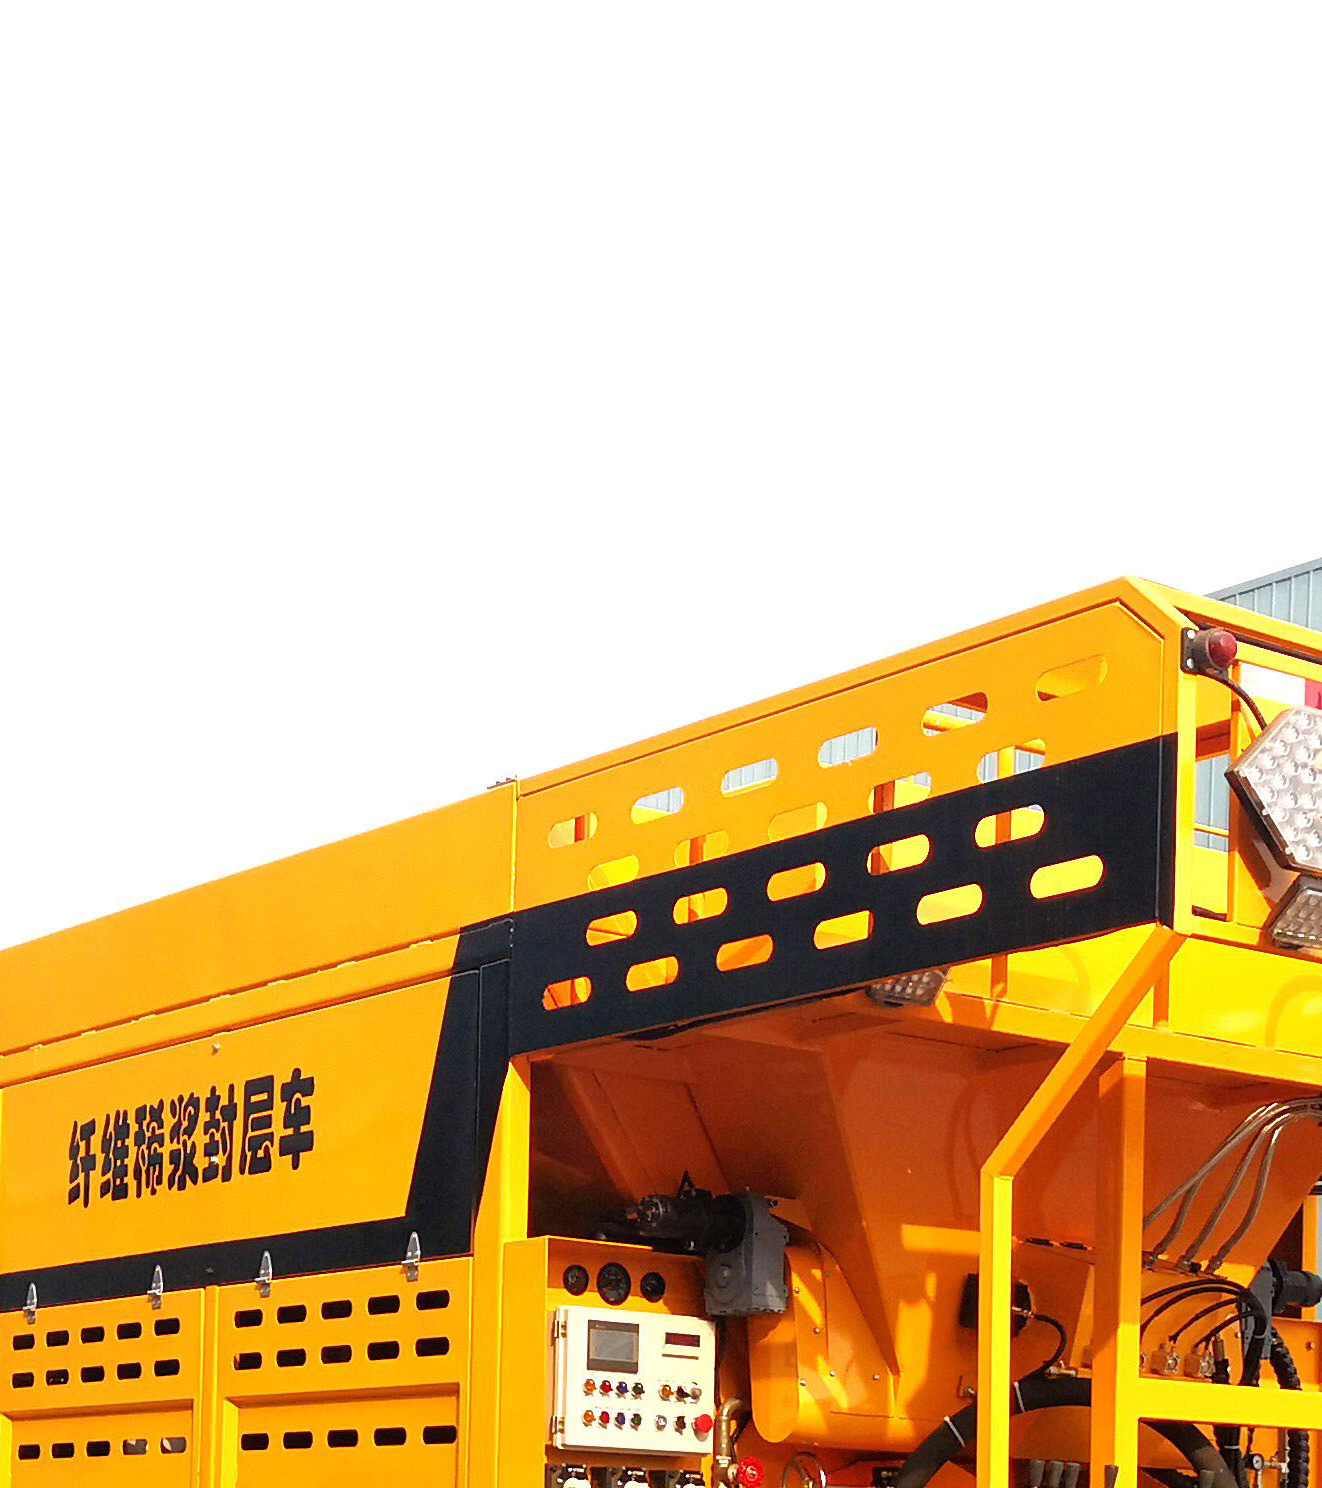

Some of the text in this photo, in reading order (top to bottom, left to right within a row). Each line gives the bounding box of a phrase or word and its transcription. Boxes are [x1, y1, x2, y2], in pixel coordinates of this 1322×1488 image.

[68, 1067, 315, 1208] 纤维稀浆封层车
